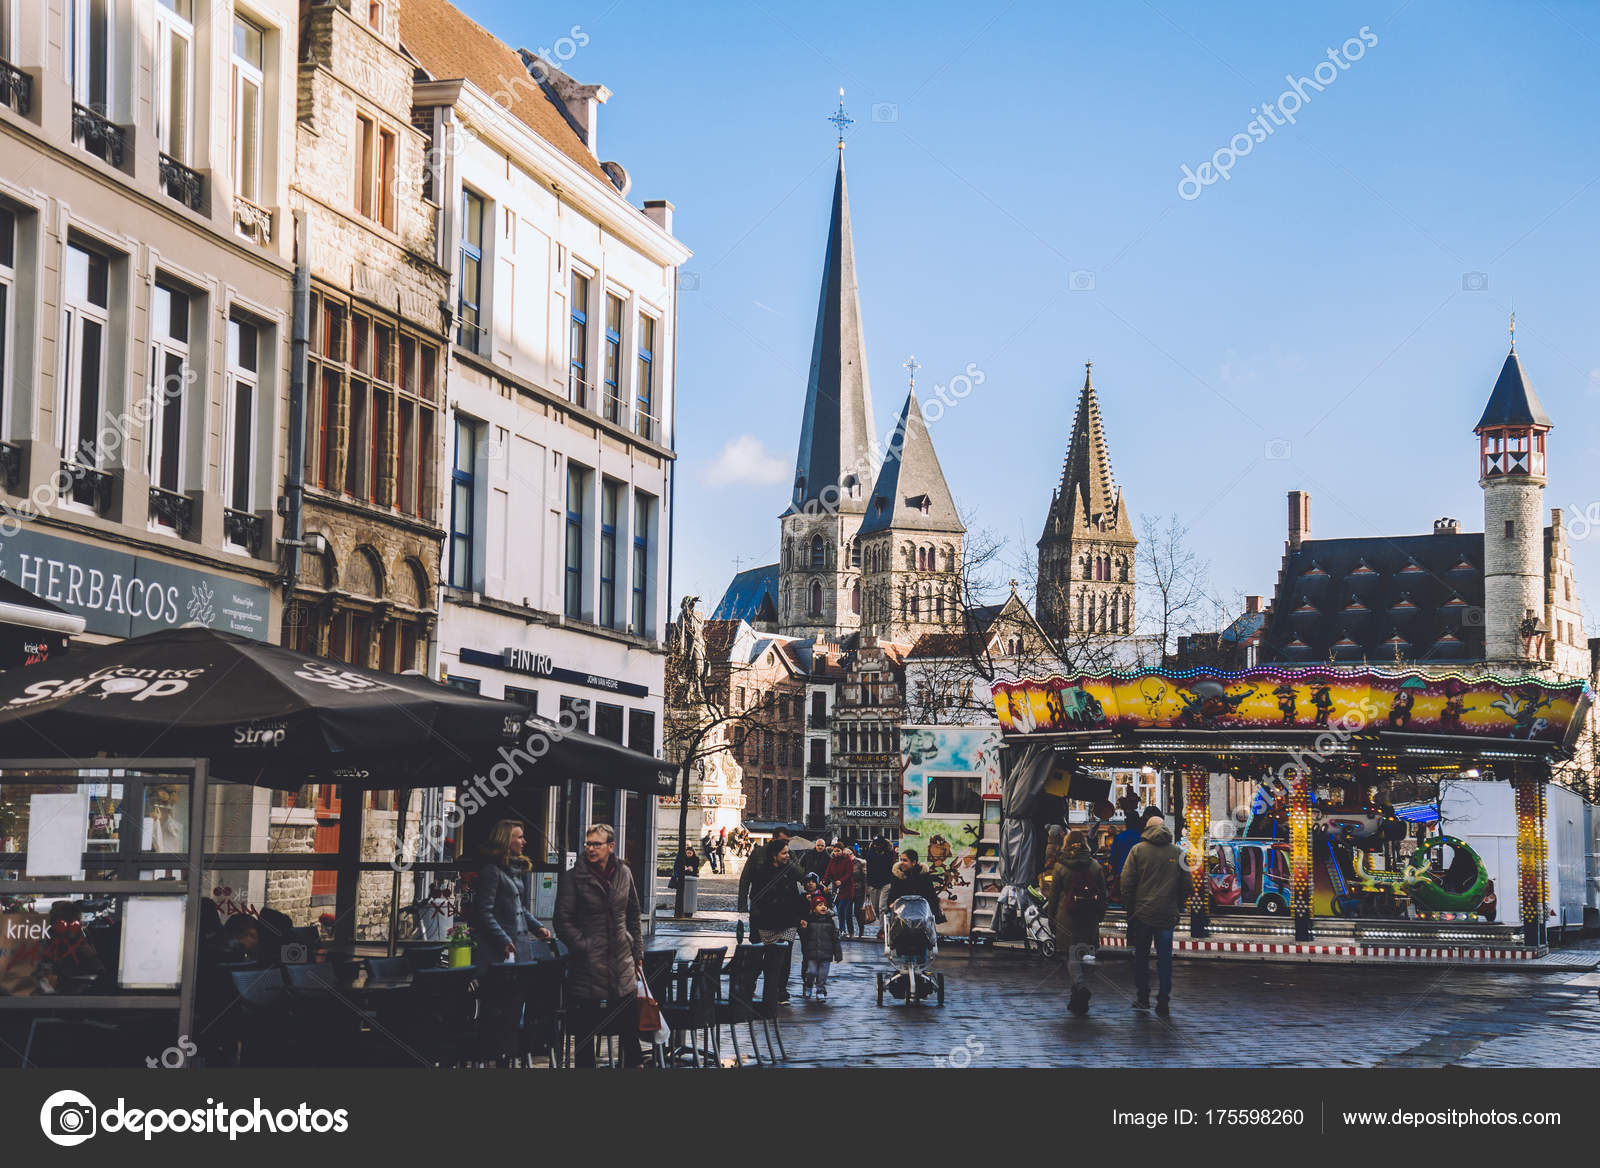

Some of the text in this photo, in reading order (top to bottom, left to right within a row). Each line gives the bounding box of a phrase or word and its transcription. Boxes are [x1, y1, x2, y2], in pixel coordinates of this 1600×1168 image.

[20, 553, 179, 624] HERBACOS
[510, 649, 553, 675] FINTRO
[9, 674, 189, 703] Strop
[234, 725, 286, 747] Strop
[7, 919, 52, 939] kriek
